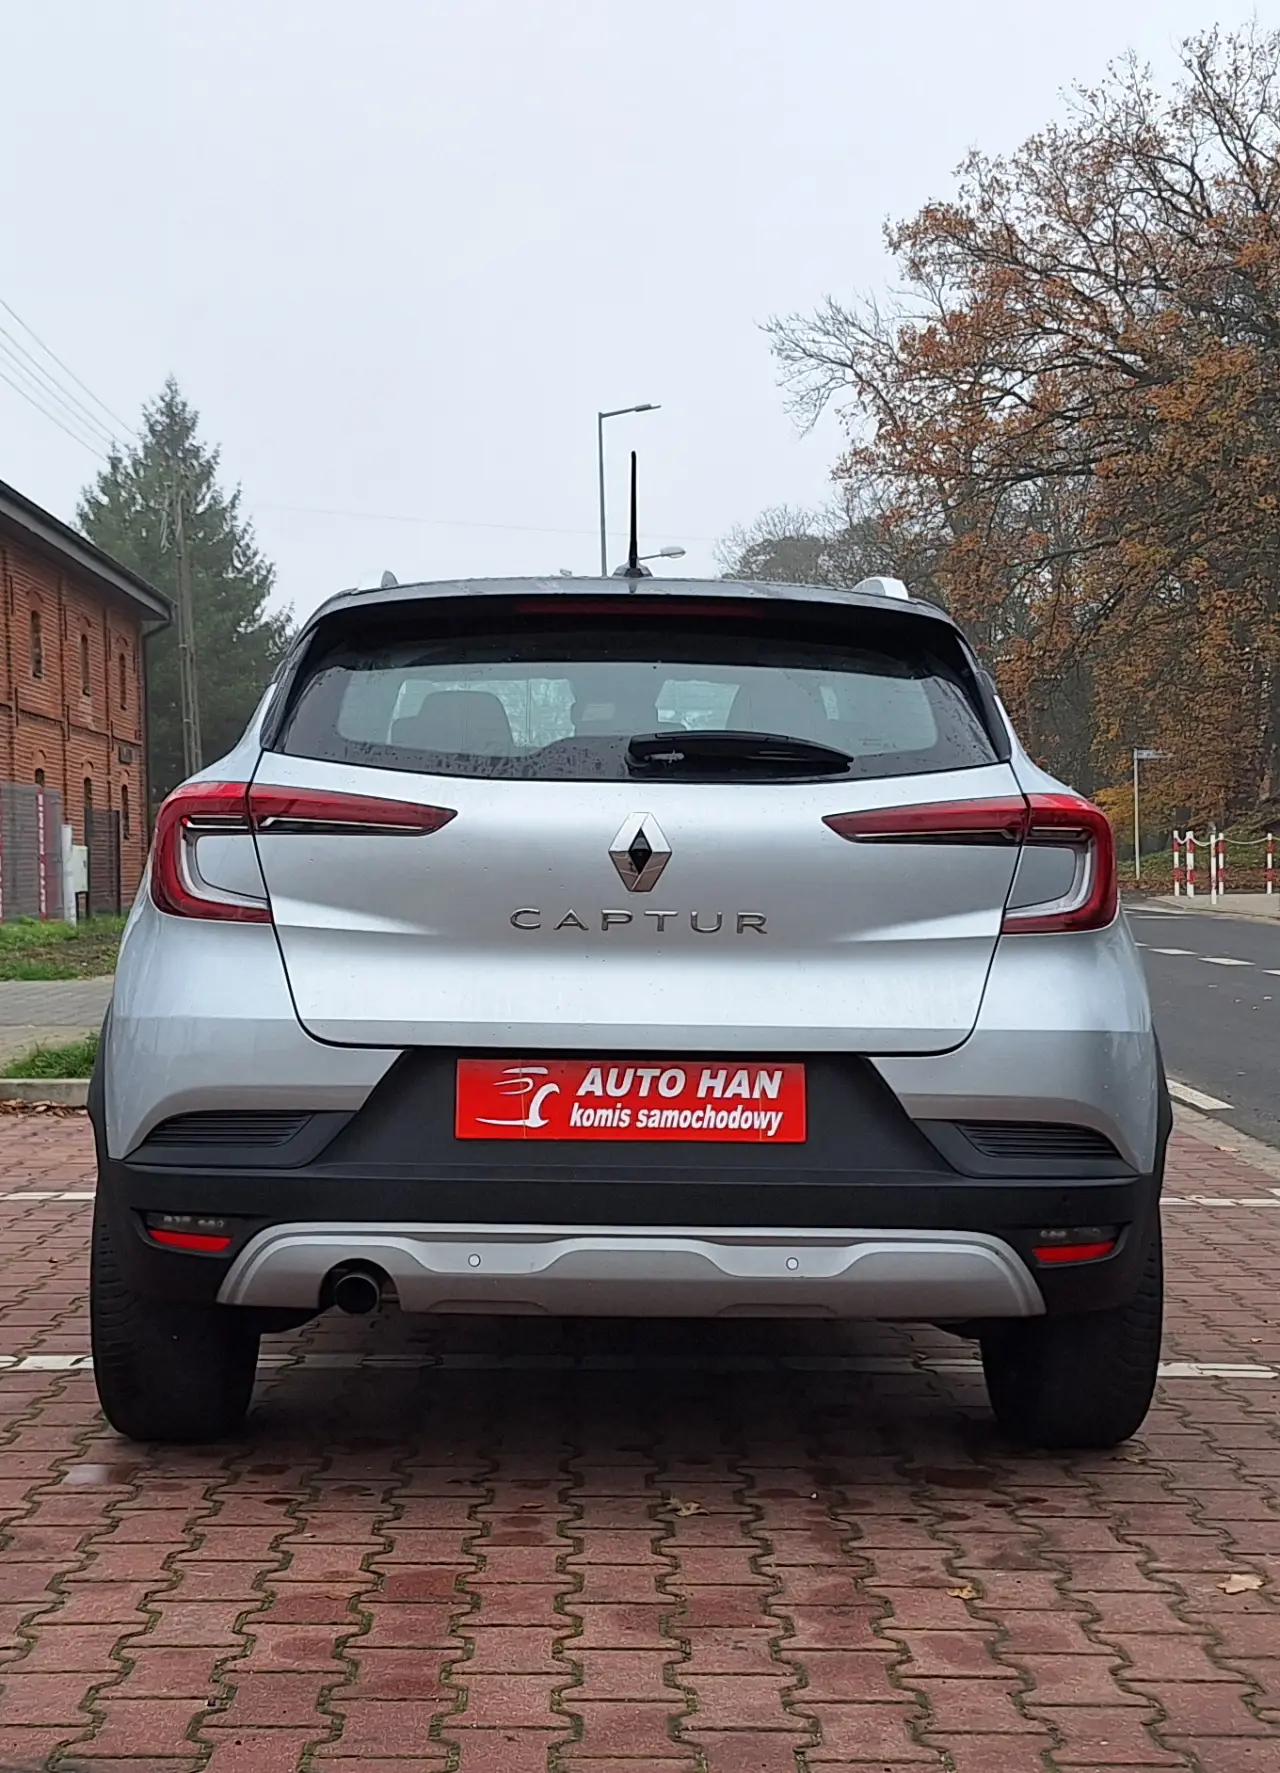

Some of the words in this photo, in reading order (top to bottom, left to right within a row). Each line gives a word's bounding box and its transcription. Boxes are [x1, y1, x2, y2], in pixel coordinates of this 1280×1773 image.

[510, 908, 768, 935] CAPTUR
[575, 1067, 686, 1098] AUTO
[696, 1069, 783, 1100] HAN
[569, 1102, 631, 1129] komis
[635, 1104, 784, 1137] samochodowy
